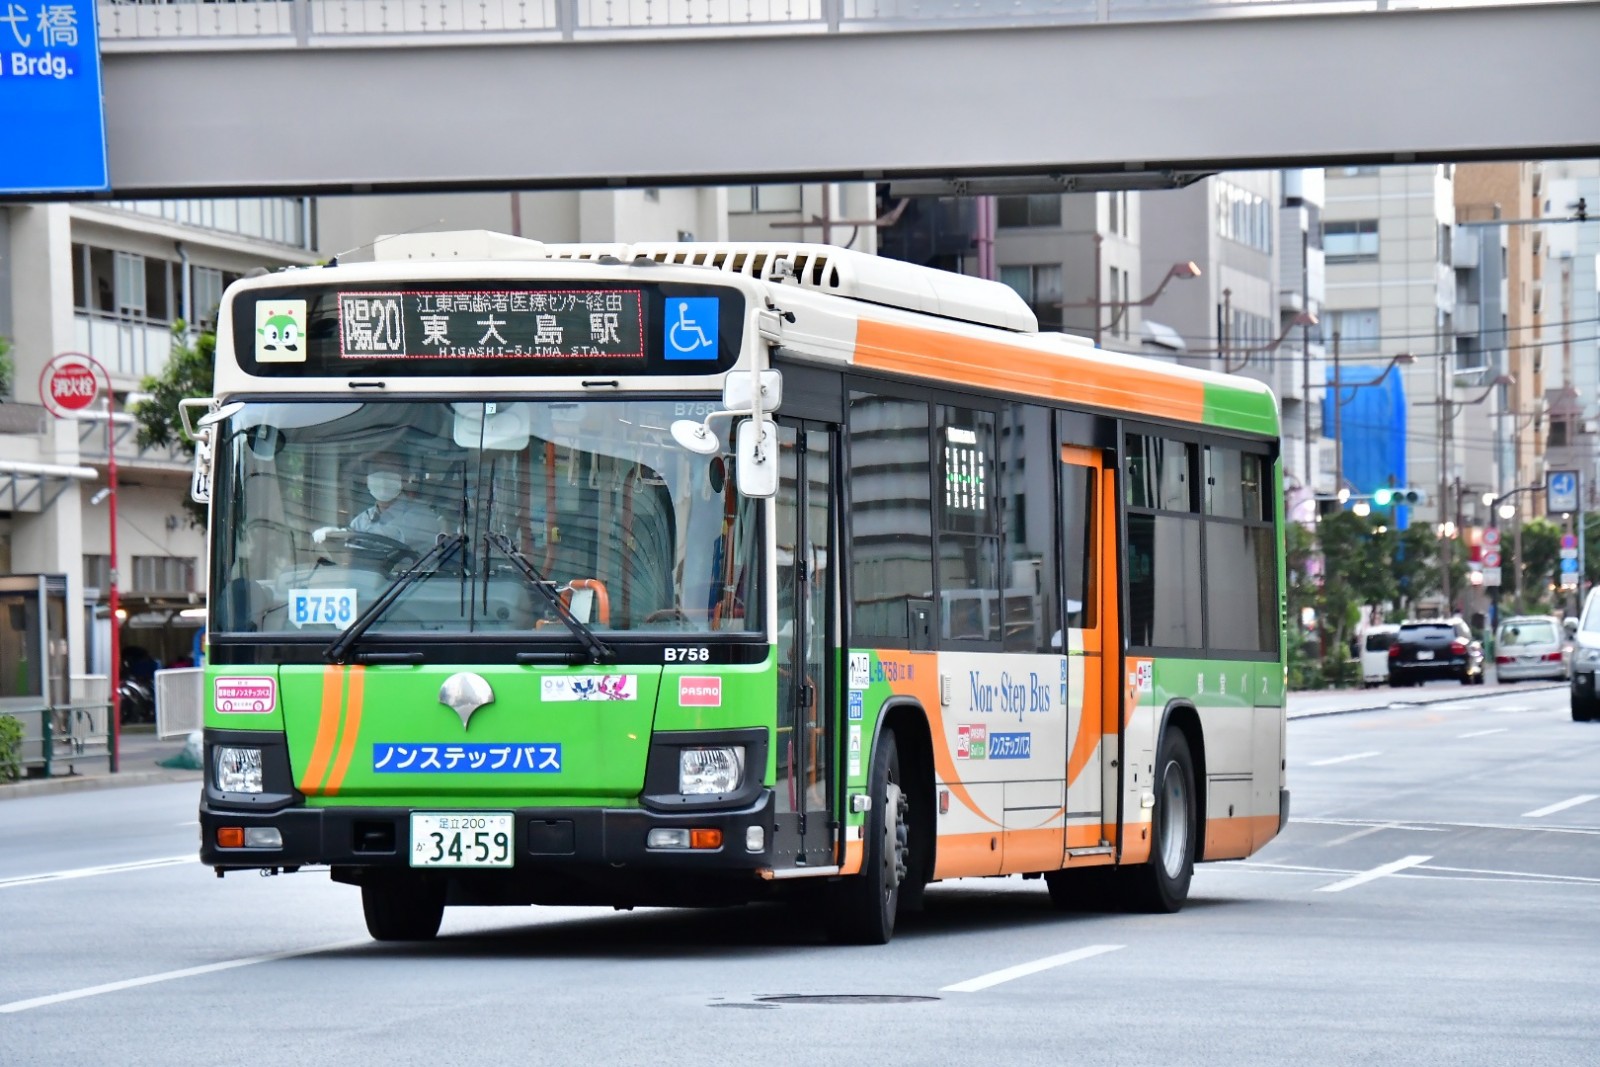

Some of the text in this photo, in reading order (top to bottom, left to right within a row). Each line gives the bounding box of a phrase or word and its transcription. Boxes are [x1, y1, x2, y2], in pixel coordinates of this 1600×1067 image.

[11, 52, 74, 80] Brdg.
[343, 298, 400, 351] 陽20
[570, 345, 606, 356] STA.
[674, 402, 716, 416] B758
[295, 596, 352, 623] B758
[664, 648, 710, 661] B758
[681, 687, 719, 696] PASMO
[1029, 672, 1051, 713] Bus
[989, 736, 1030, 755] ノンステップバス
[374, 746, 561, 770] ノンステップバス
[429, 831, 509, 862] 34-59
